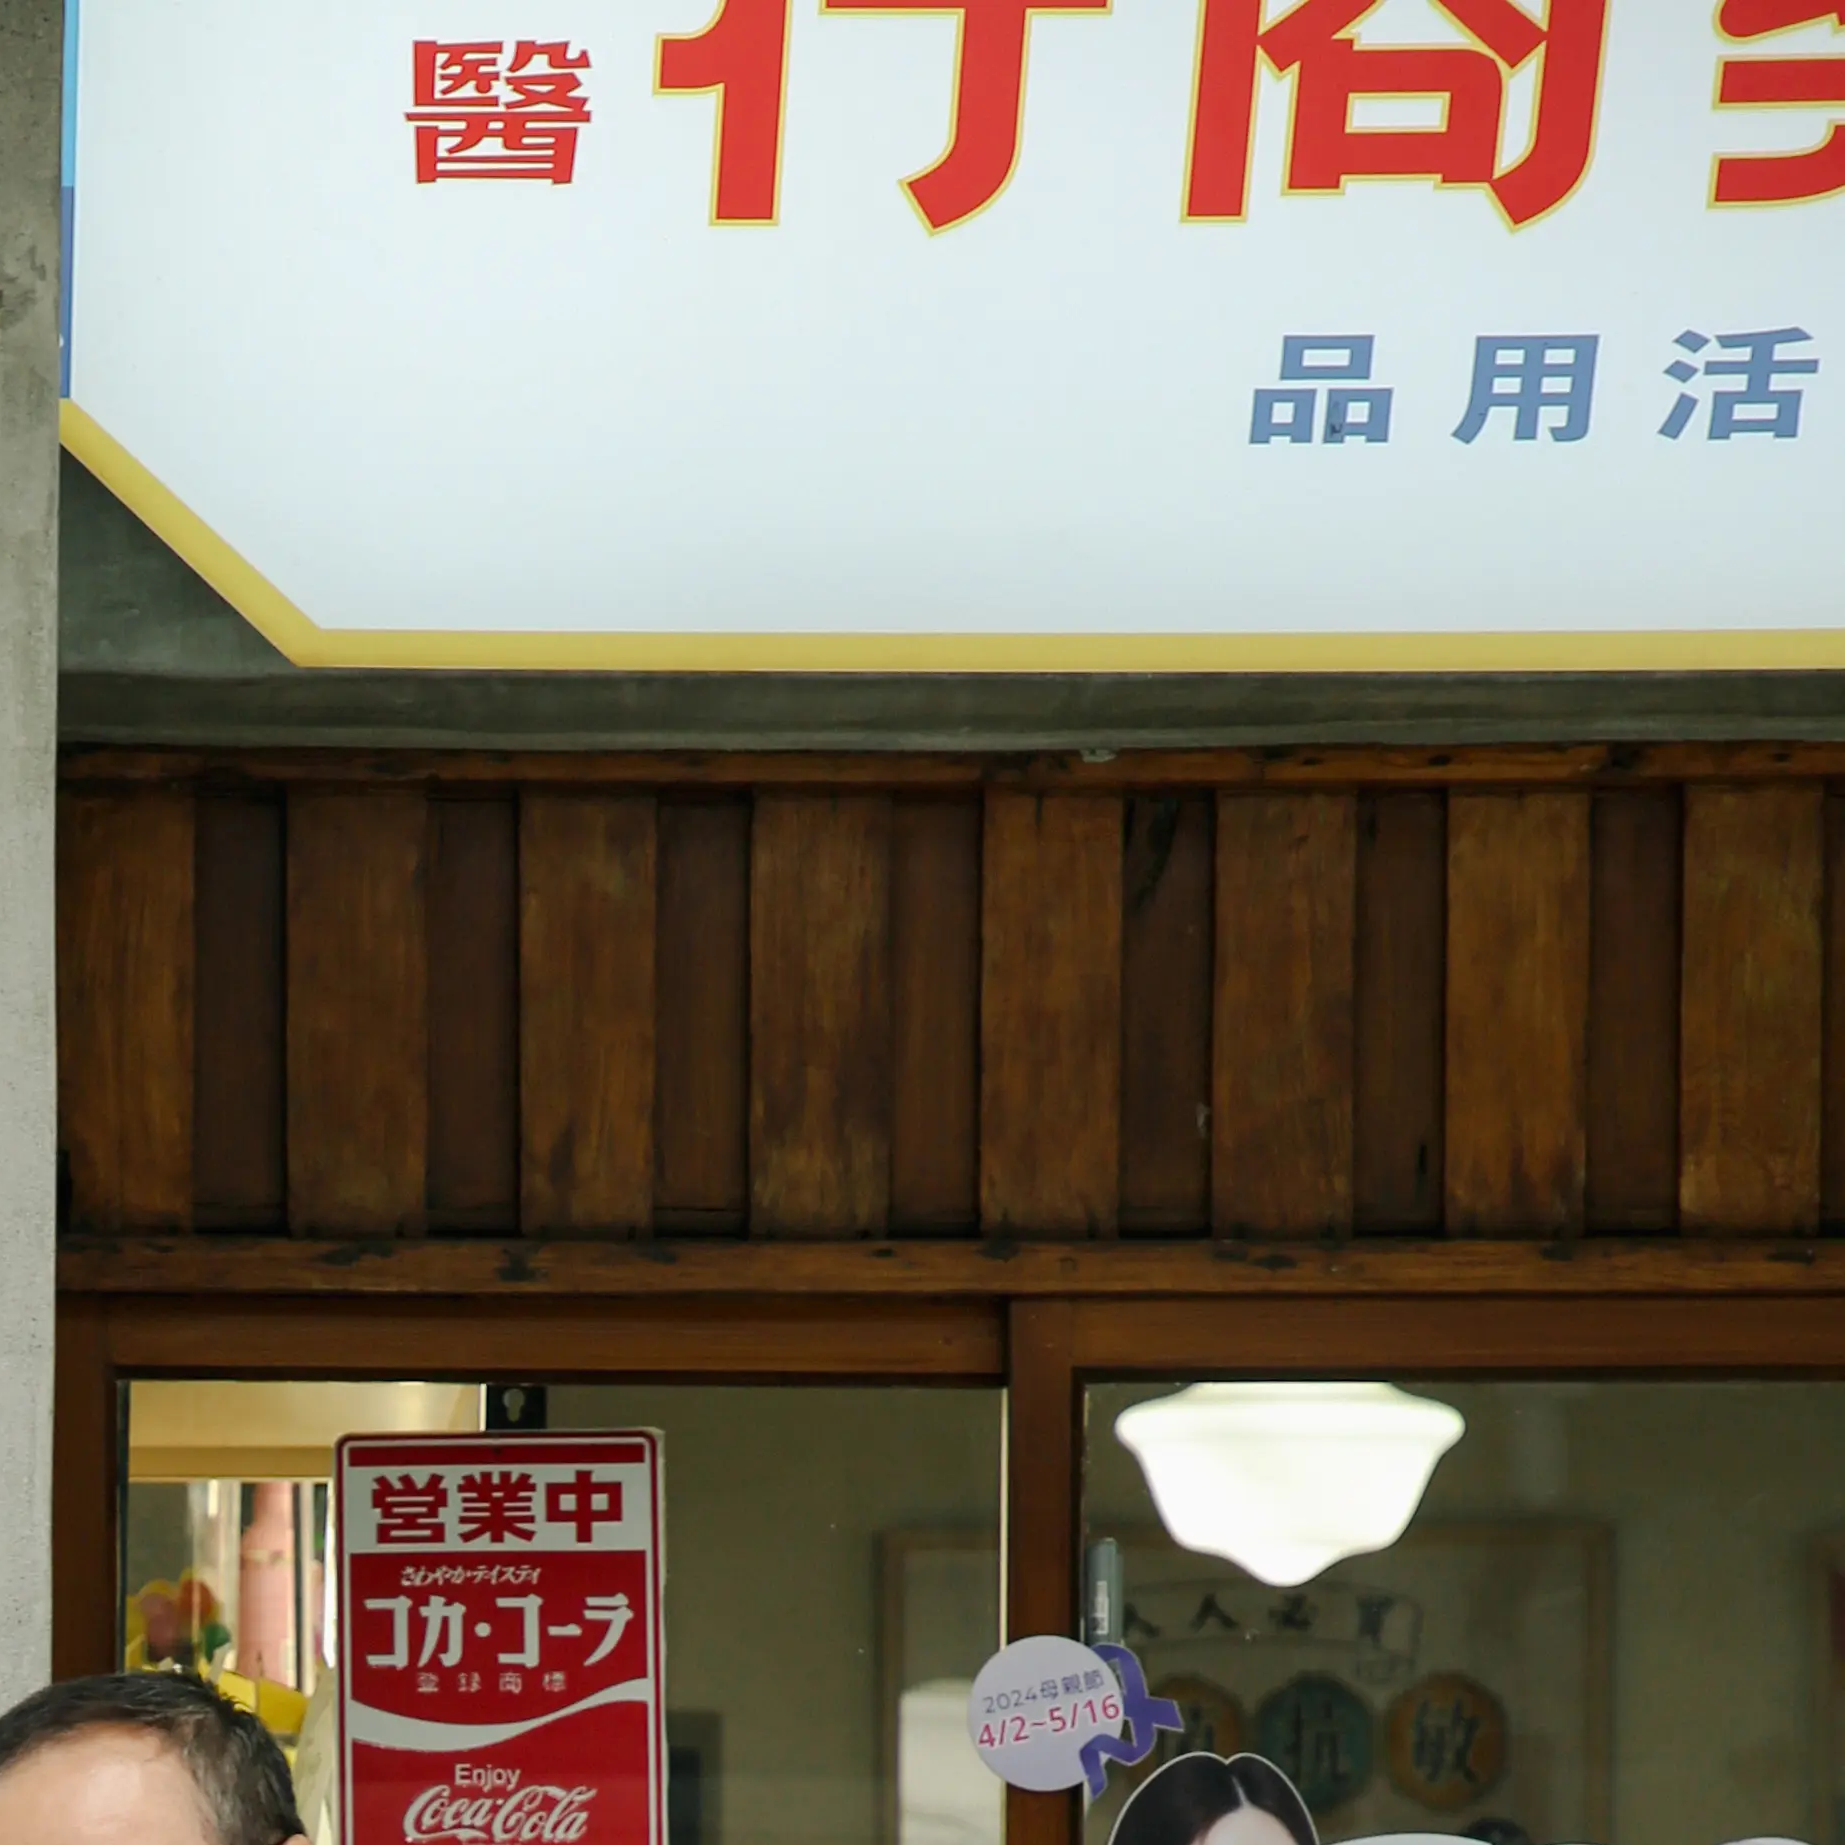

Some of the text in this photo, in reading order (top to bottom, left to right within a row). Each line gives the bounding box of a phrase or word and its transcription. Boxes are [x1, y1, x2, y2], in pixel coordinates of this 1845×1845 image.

[405, 40, 593, 185] 醫
[371, 1470, 623, 1545] 営業中
[455, 1763, 521, 1793] Enjoy
[402, 1785, 598, 1843] Coca-Cola
